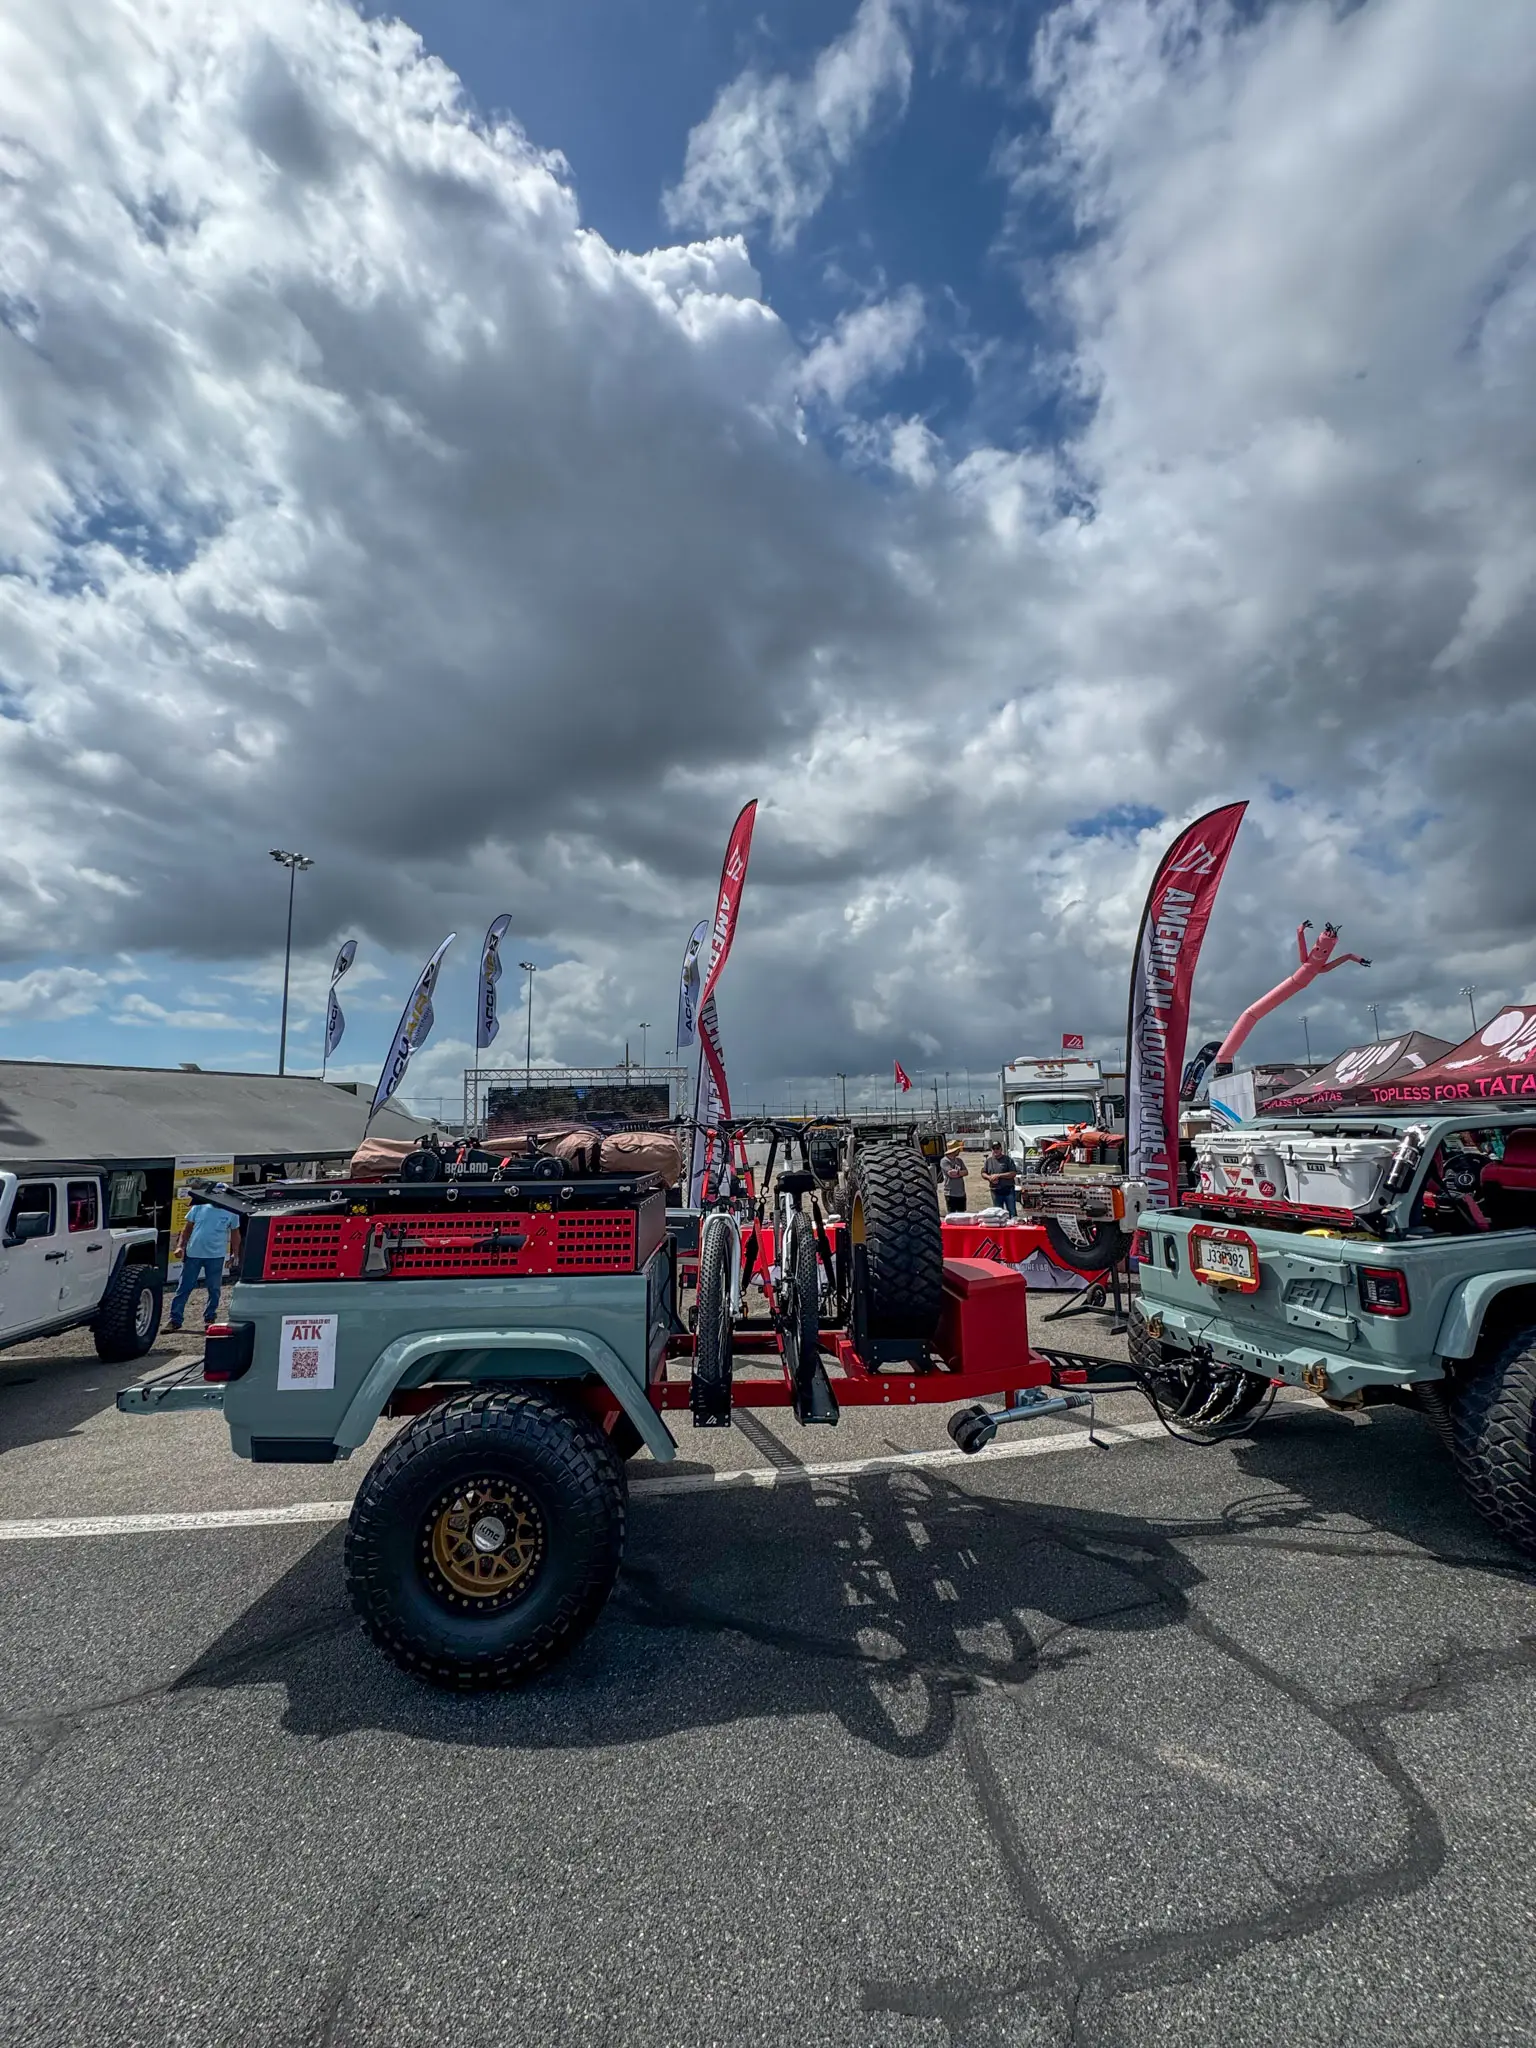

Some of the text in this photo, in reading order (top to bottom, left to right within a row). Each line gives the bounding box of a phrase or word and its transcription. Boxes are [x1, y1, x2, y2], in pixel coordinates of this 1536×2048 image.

[1143, 886, 1196, 1010] AMERICAN
[1139, 1013, 1169, 1156] ADVENTURE
[1370, 1073, 1536, 1103] TOPLESS FOR TATA
[1311, 1091, 1343, 1103] TATAS
[1308, 1163, 1325, 1171] YETI
[291, 1325, 322, 1341] ATK
